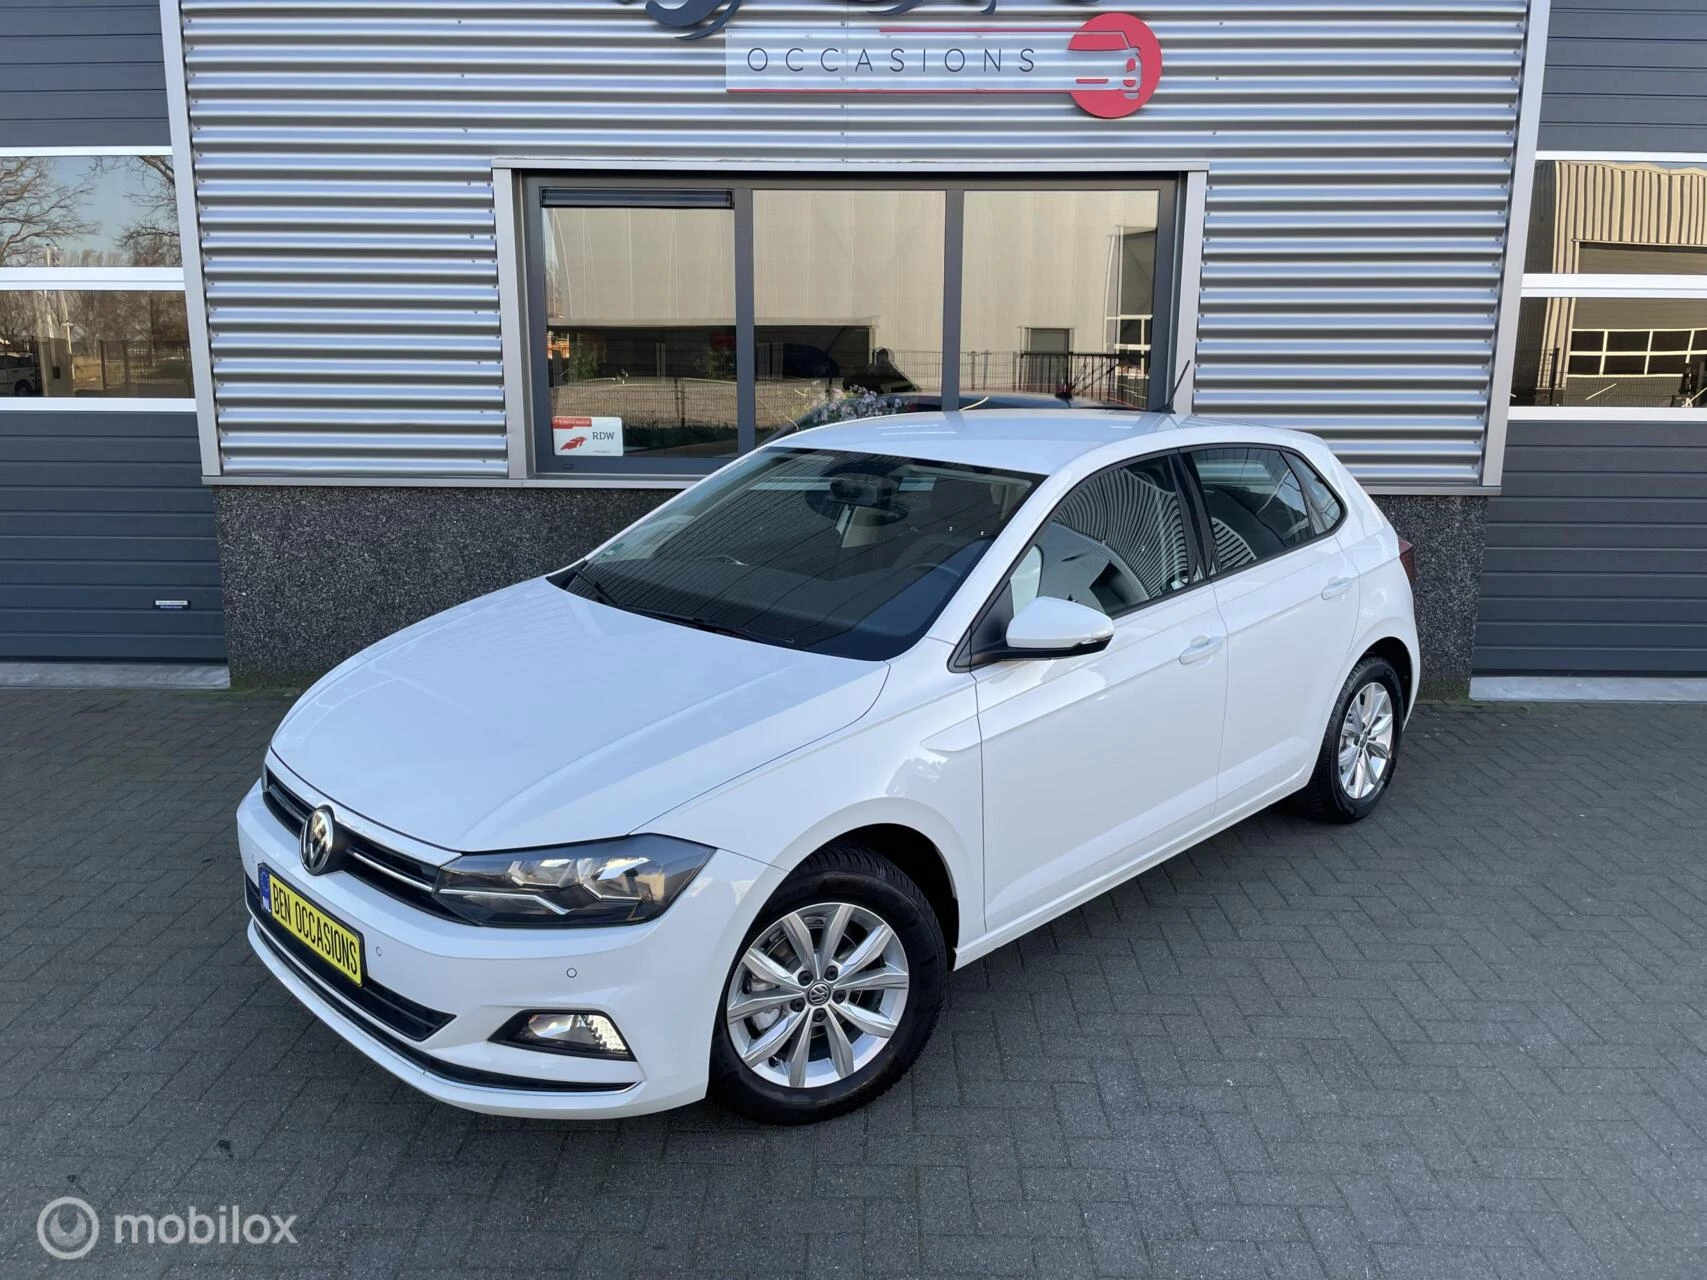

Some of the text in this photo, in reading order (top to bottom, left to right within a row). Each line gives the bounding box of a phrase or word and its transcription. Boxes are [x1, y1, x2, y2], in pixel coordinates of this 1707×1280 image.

[747, 47, 1036, 73] OCCASIONS
[592, 431, 615, 441] RDW
[272, 883, 357, 975] BEN OCCASIONS
